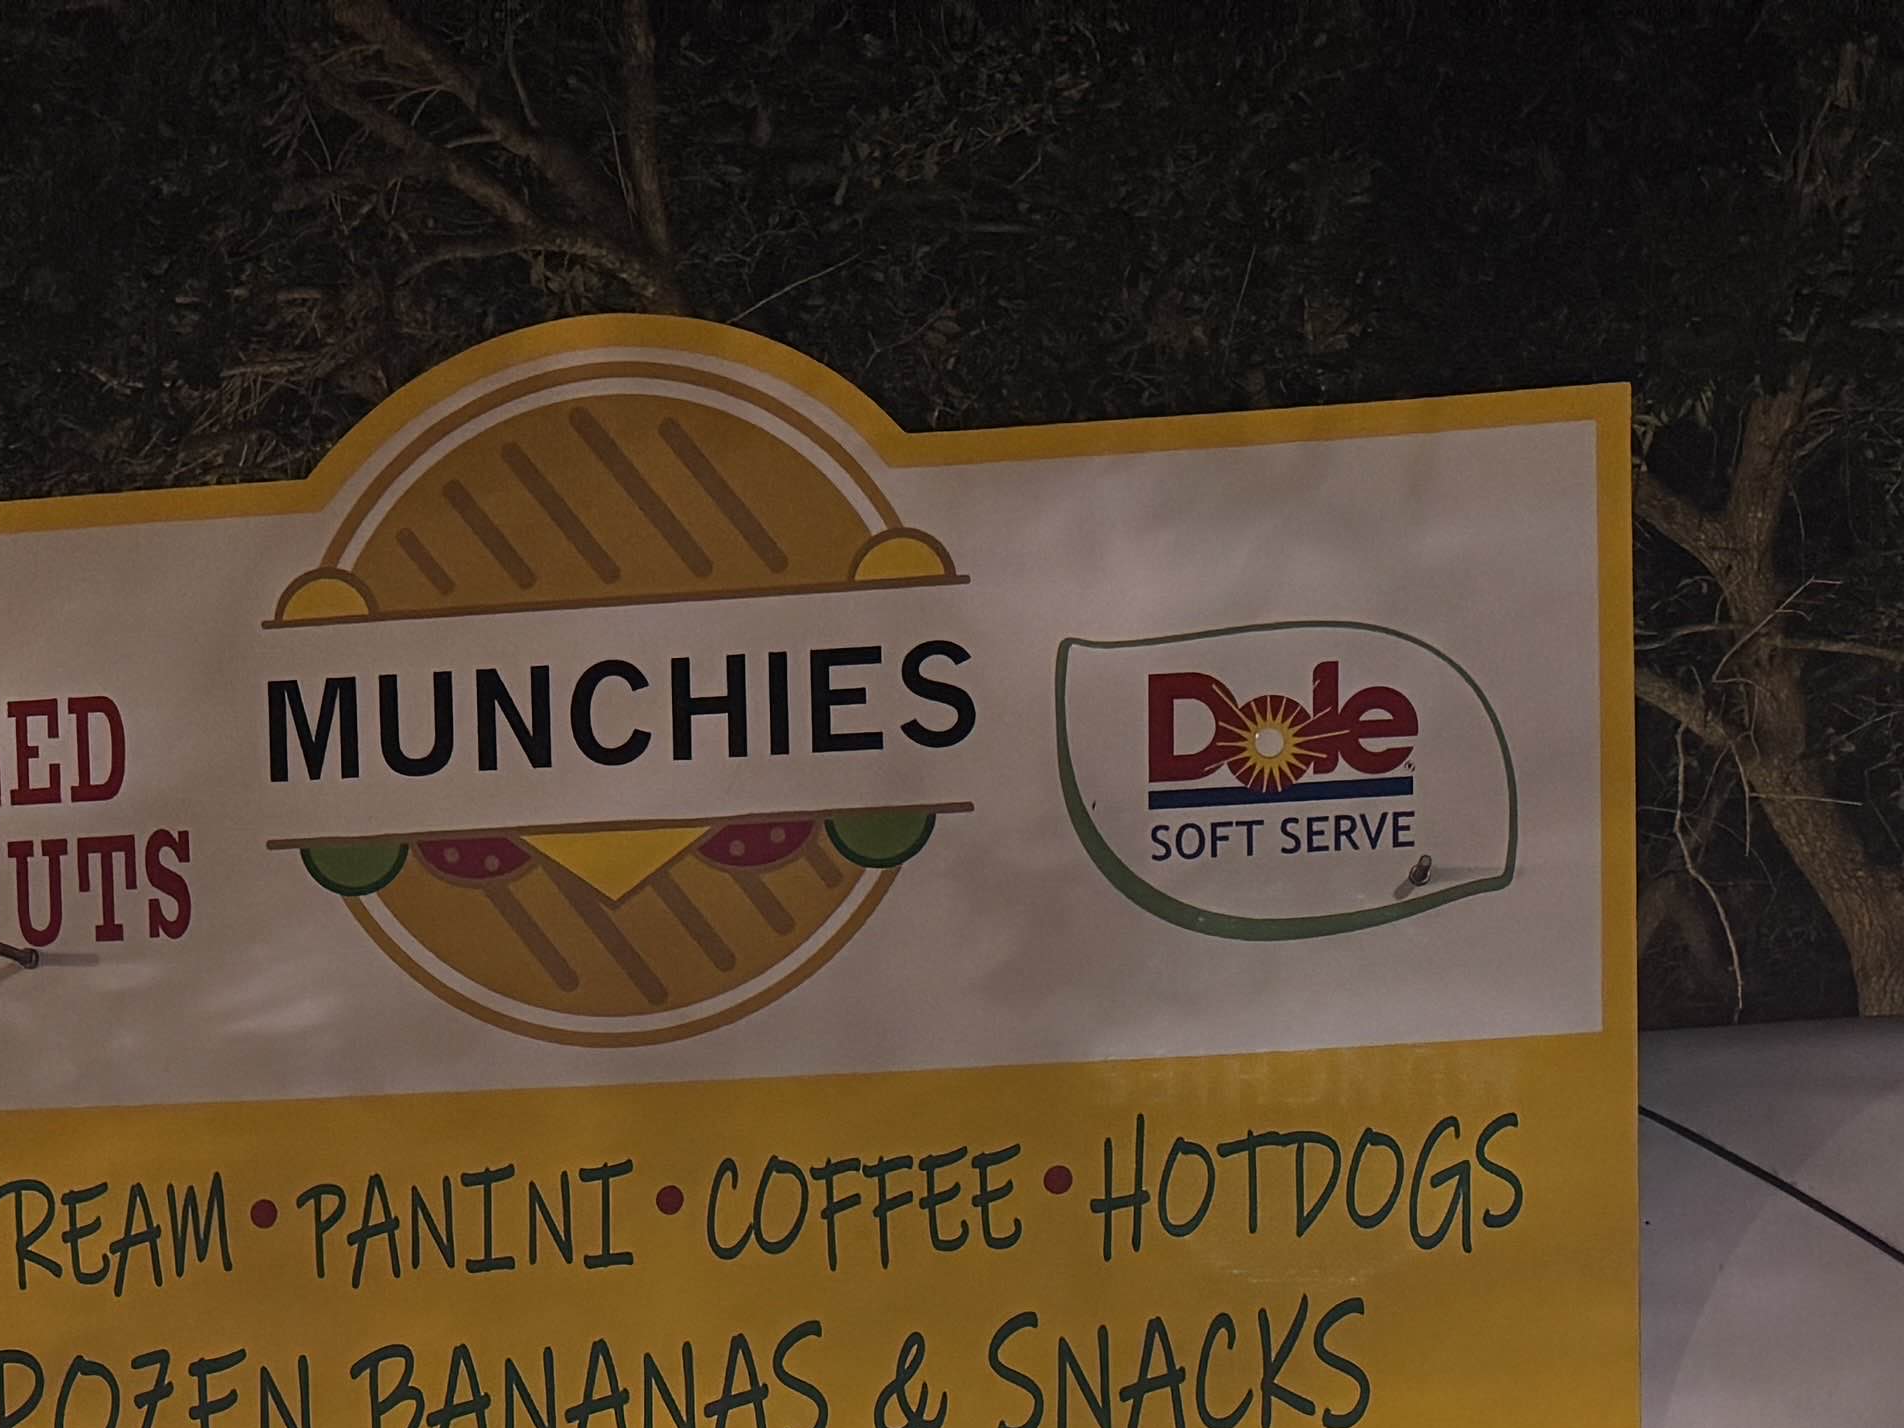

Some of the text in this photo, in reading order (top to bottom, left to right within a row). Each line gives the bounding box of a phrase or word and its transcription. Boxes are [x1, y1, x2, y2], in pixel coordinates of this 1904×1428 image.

[268, 640, 976, 782] MUNCHIES
[1148, 661, 1419, 790] Dole
[1151, 811, 1414, 861] SOFT SERVE
[296, 1159, 633, 1289] PANINI
[707, 1144, 1022, 1271] COFFEE
[1090, 1112, 1524, 1262] HOTDOGS
